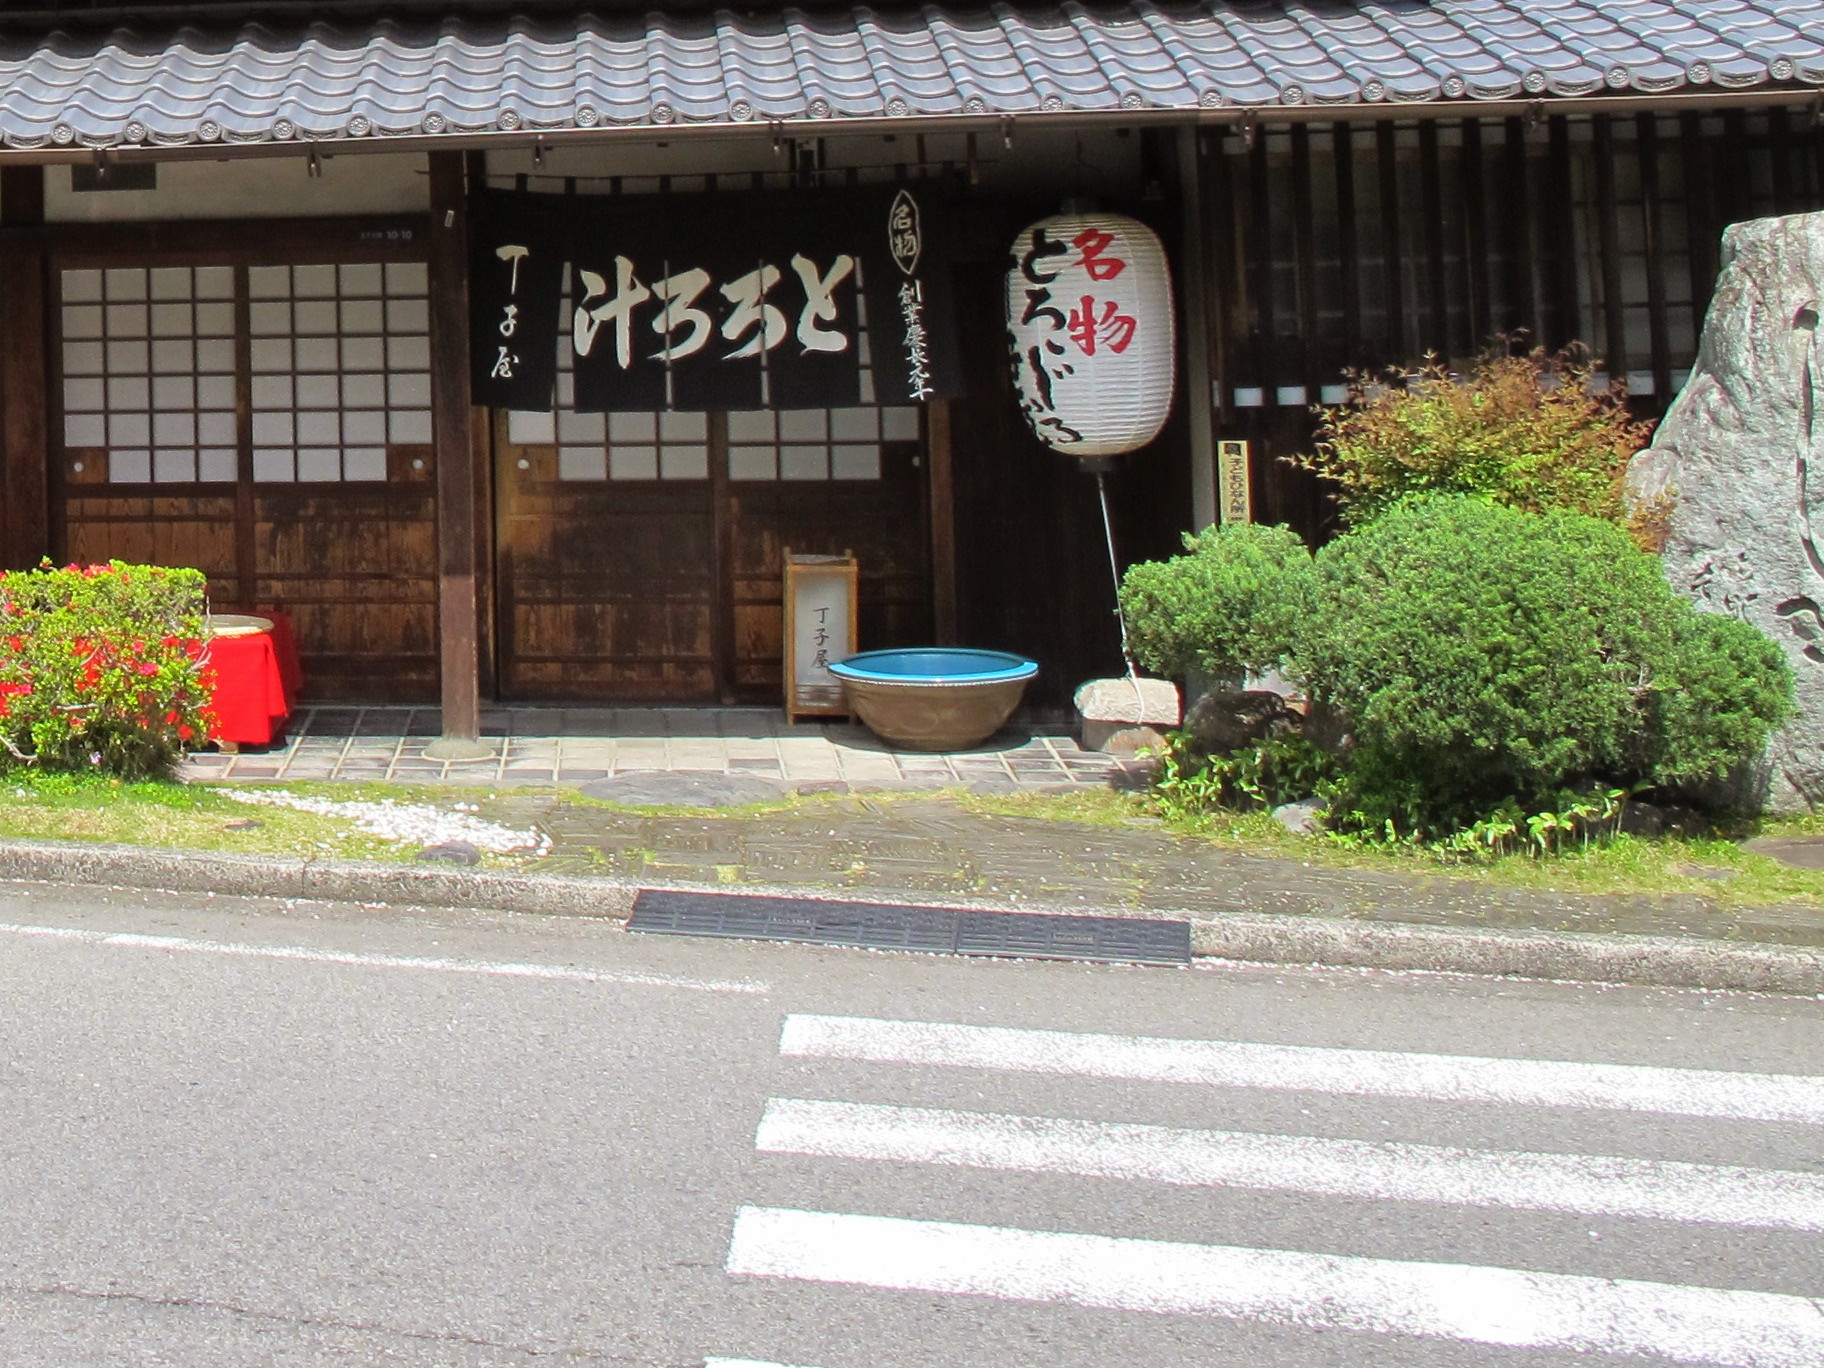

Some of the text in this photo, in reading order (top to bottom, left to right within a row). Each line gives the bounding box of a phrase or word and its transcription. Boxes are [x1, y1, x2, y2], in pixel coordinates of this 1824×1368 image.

[892, 203, 918, 257] 名物
[490, 244, 530, 378] 丁子屋
[574, 252, 854, 370] とろろ汁
[1066, 227, 1137, 357] 名物
[811, 606, 831, 669] 丁子屋
